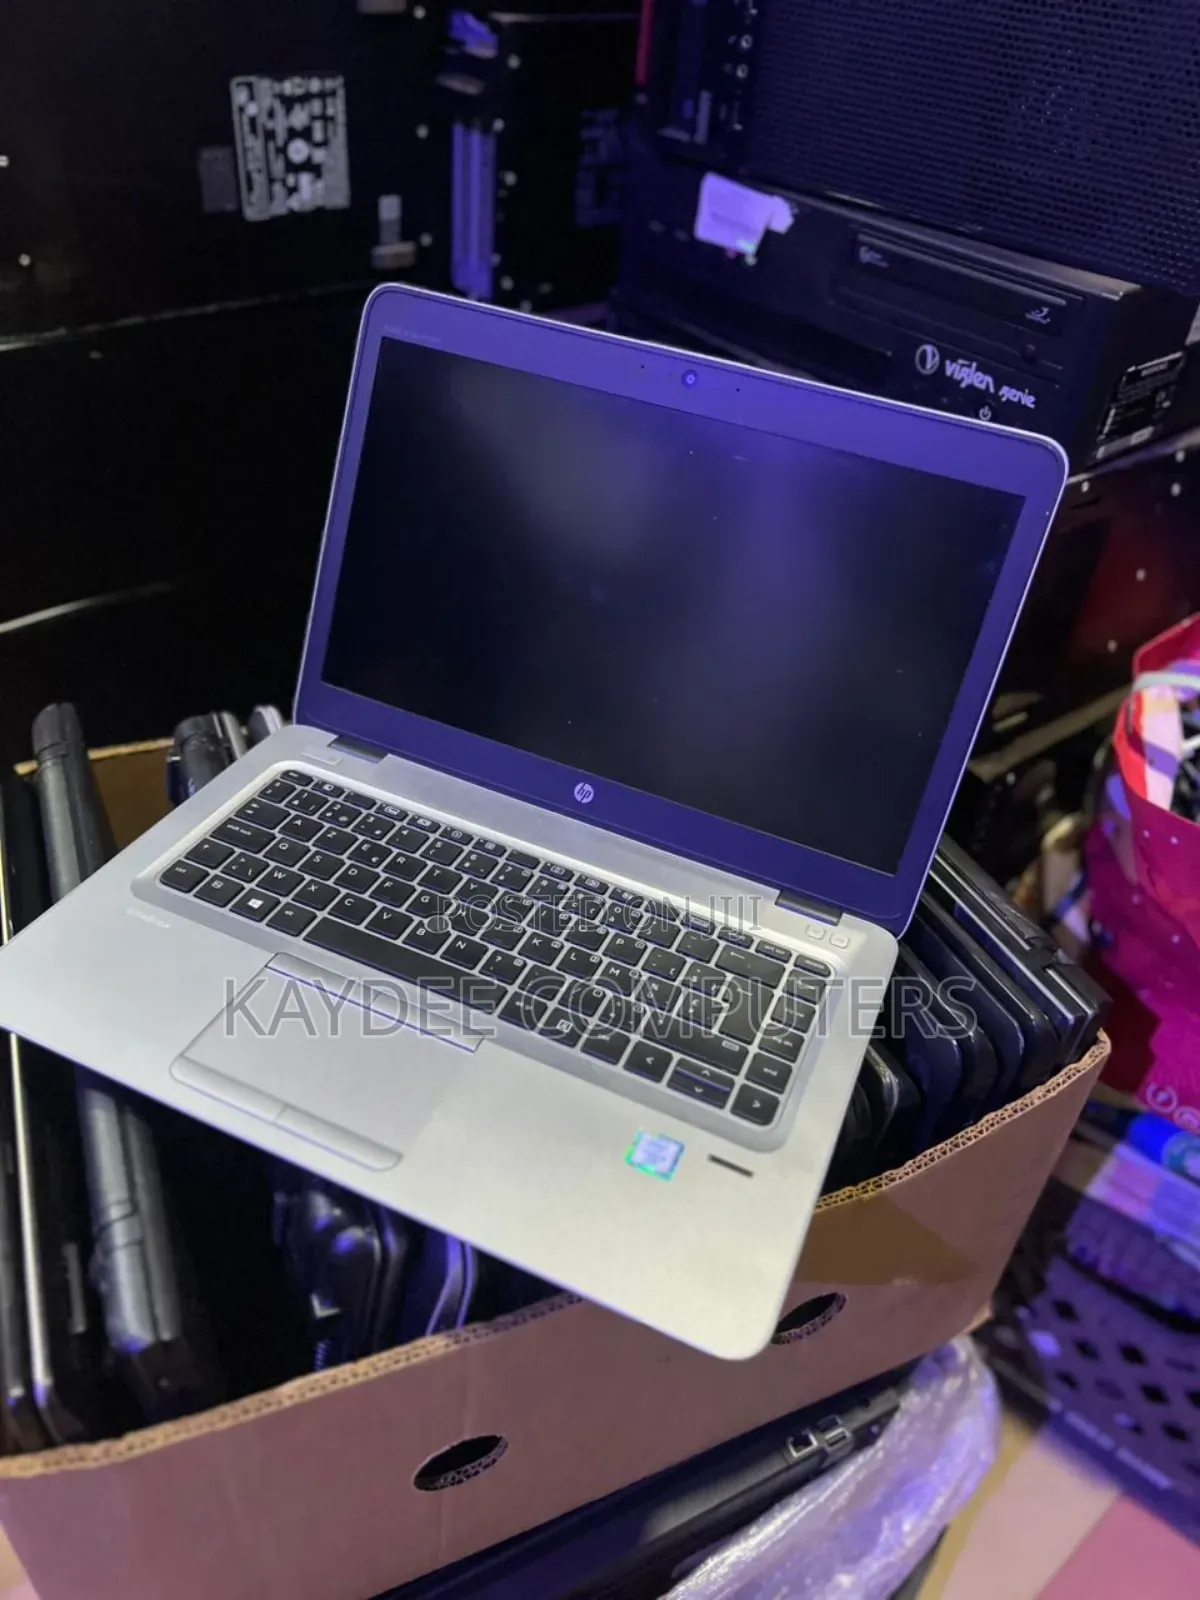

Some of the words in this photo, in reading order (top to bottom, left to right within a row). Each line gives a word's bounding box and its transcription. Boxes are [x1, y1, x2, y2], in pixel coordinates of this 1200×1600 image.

[944, 359, 995, 394] viglen
[998, 385, 1037, 409] genie
[573, 782, 595, 804] hp
